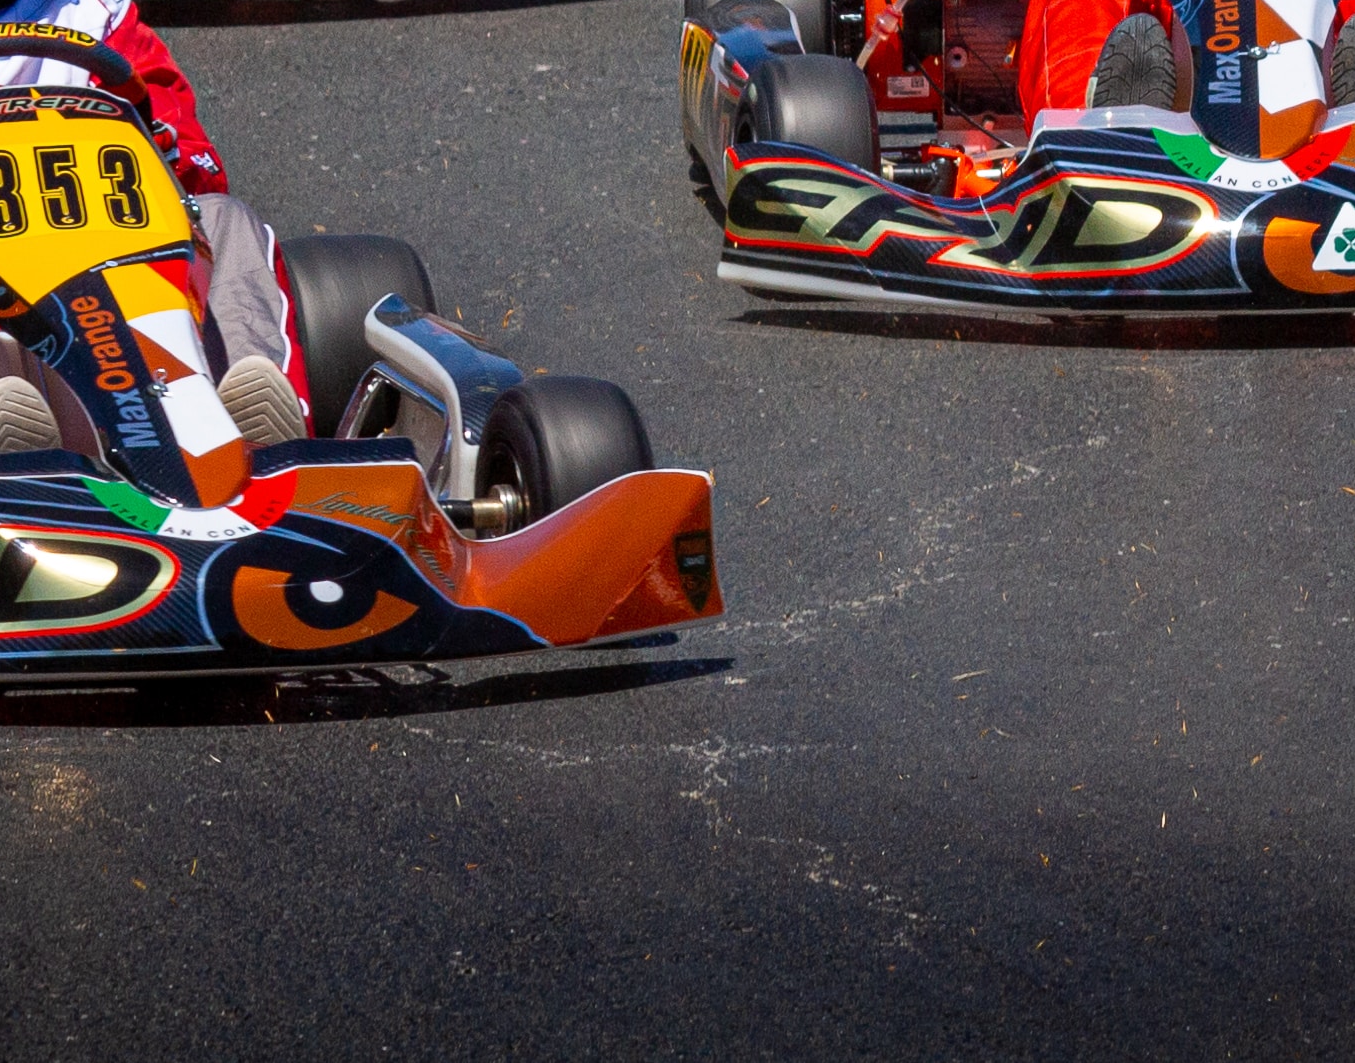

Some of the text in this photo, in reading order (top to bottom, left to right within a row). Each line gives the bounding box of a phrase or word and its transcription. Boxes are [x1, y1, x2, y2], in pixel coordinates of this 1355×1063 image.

[1171, 150, 1332, 189] ITALIAN CONCEPT
[110, 492, 193, 537] ITALIAN
